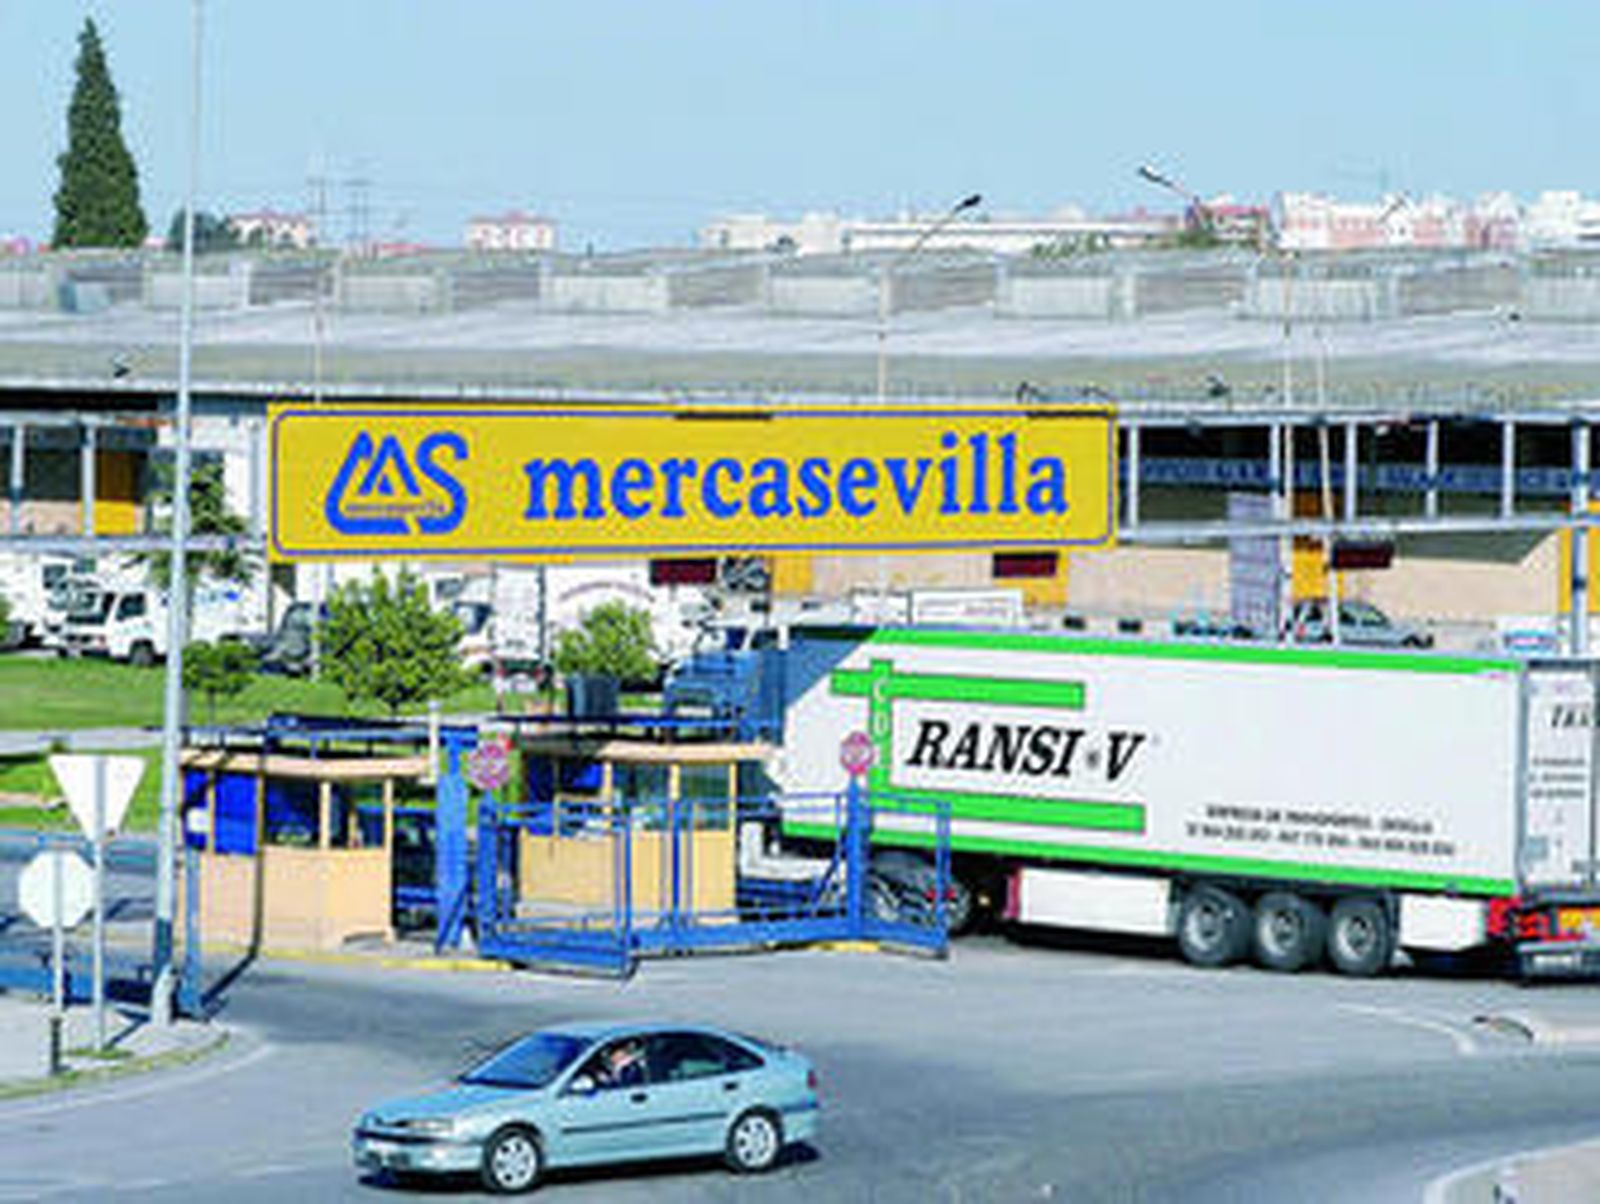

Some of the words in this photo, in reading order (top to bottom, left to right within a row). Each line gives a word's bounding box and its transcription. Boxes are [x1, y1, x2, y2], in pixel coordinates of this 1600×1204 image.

[523, 431, 1070, 520] mercasevilla
[906, 718, 1086, 778] RANSI
[1104, 730, 1147, 782] V
